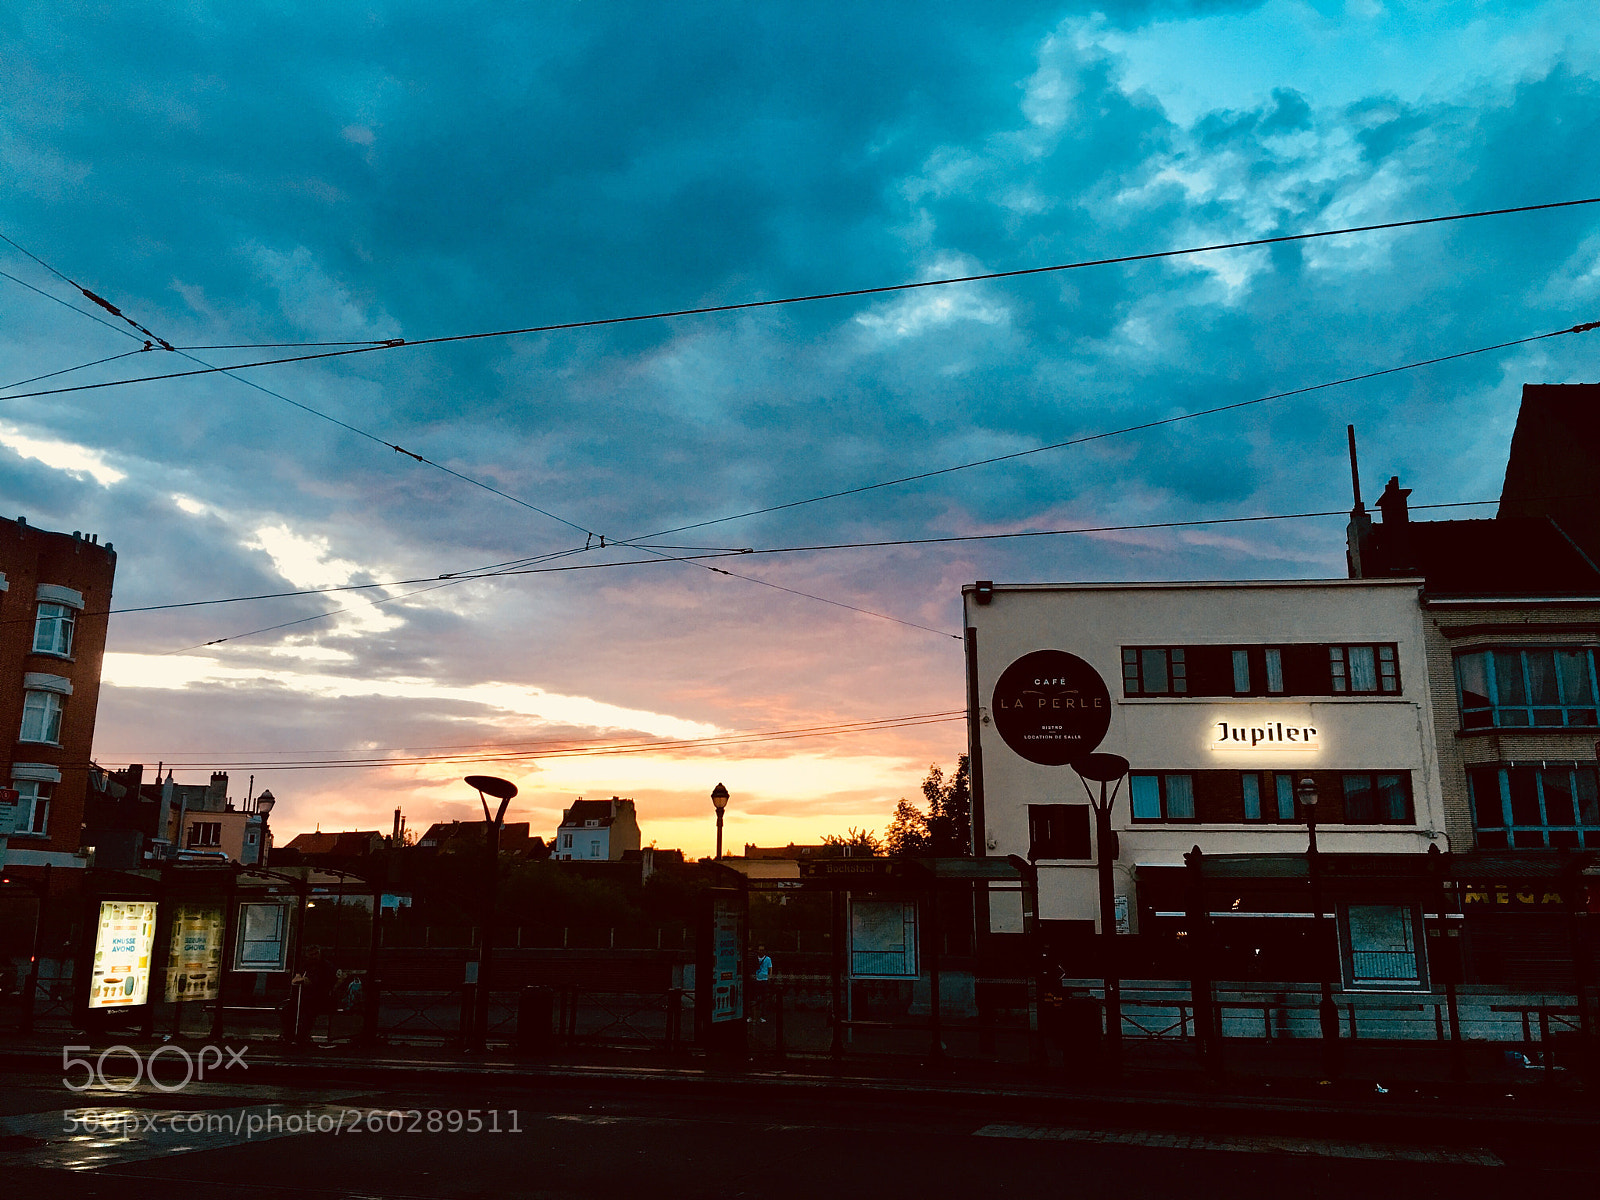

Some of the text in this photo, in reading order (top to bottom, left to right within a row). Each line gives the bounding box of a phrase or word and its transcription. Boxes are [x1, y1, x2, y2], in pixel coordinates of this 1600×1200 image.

[1034, 677, 1066, 686] CAFÉ
[1001, 697, 1102, 709] LA PERLE
[1217, 722, 1317, 747] Jupiler
[112, 945, 135, 953] AVOND
